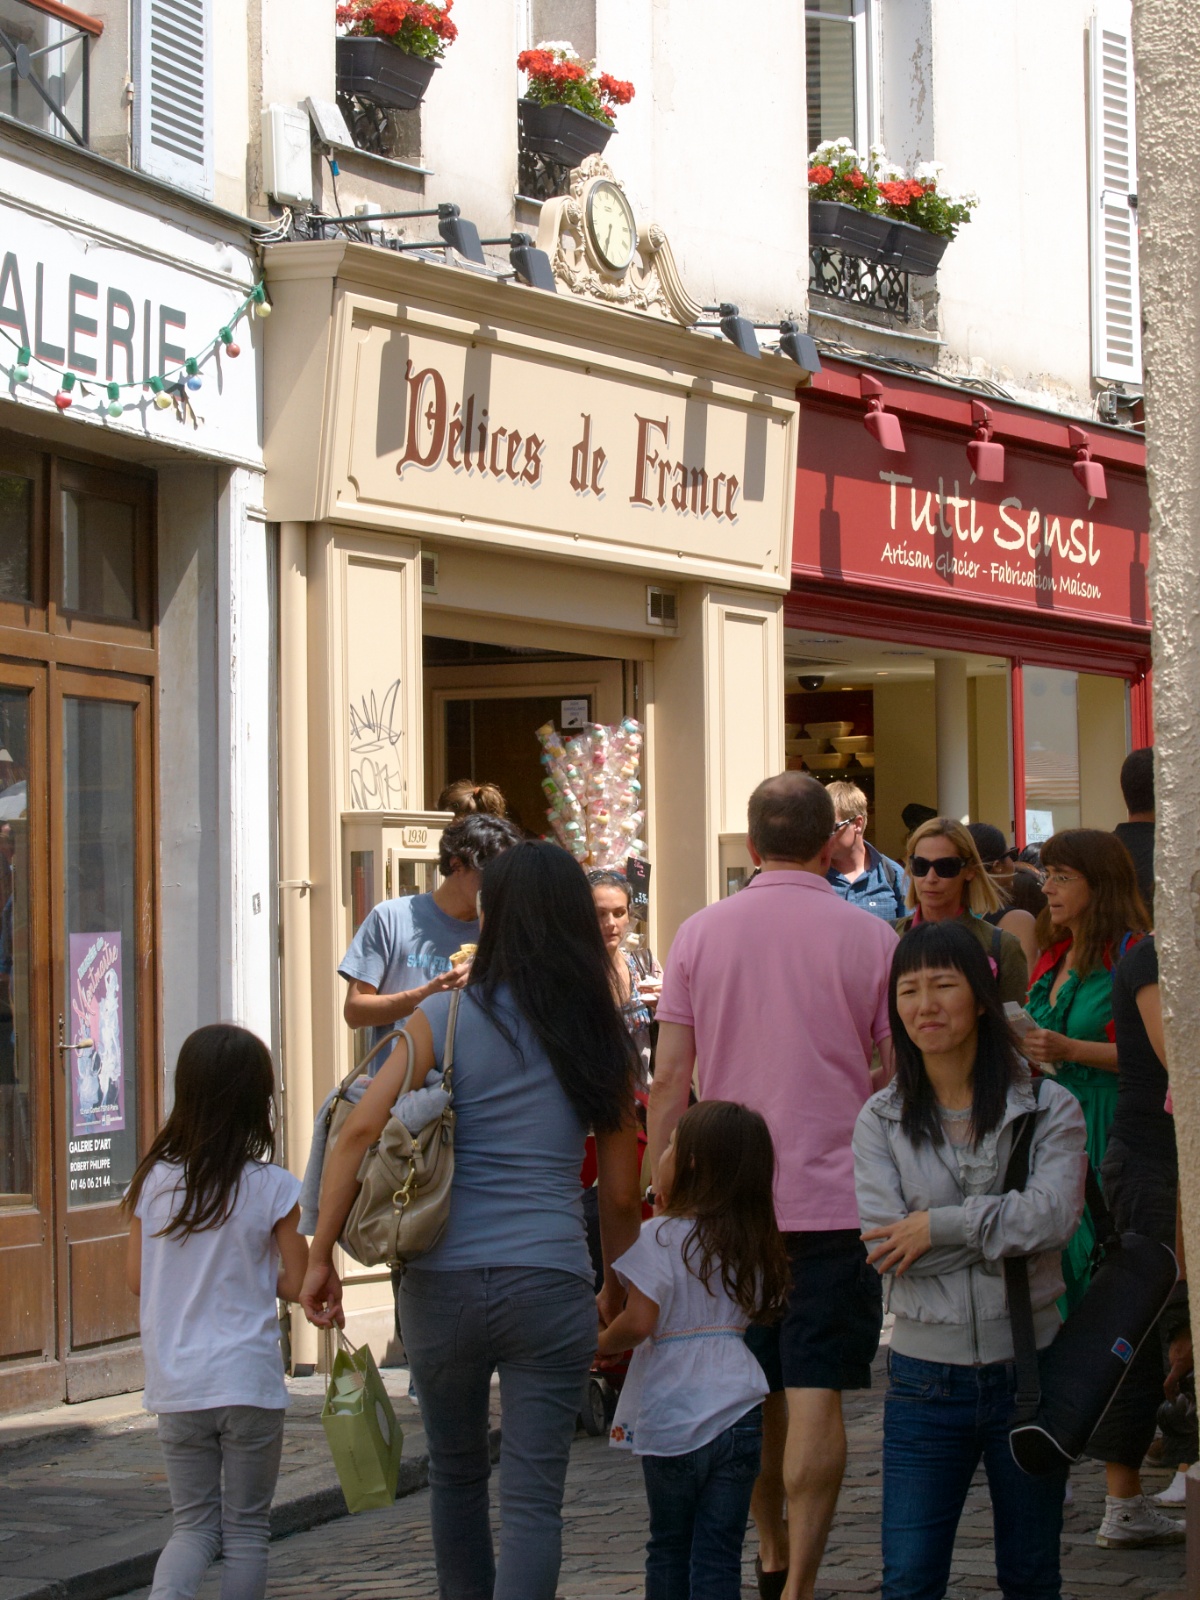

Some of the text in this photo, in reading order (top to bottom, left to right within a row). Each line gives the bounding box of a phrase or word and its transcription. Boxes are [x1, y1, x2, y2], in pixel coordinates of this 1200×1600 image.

[396, 359, 740, 522] Délices de France
[878, 470, 1101, 566] Tutti Sensi
[881, 541, 933, 569] Artisan
[935, 552, 981, 578] Glacier
[990, 560, 1057, 592] Fabrication
[1059, 573, 1102, 600] Maison
[408, 829, 428, 844] 1930
[69, 1138, 111, 1153] GALERIE D'ART
[70, 1159, 110, 1172] ROBERT PHILIPPE
[71, 1179, 77, 1190] 01
[87, 1177, 94, 1188] 06
[95, 1176, 102, 1188] 21
[103, 1175, 110, 1187] 44
